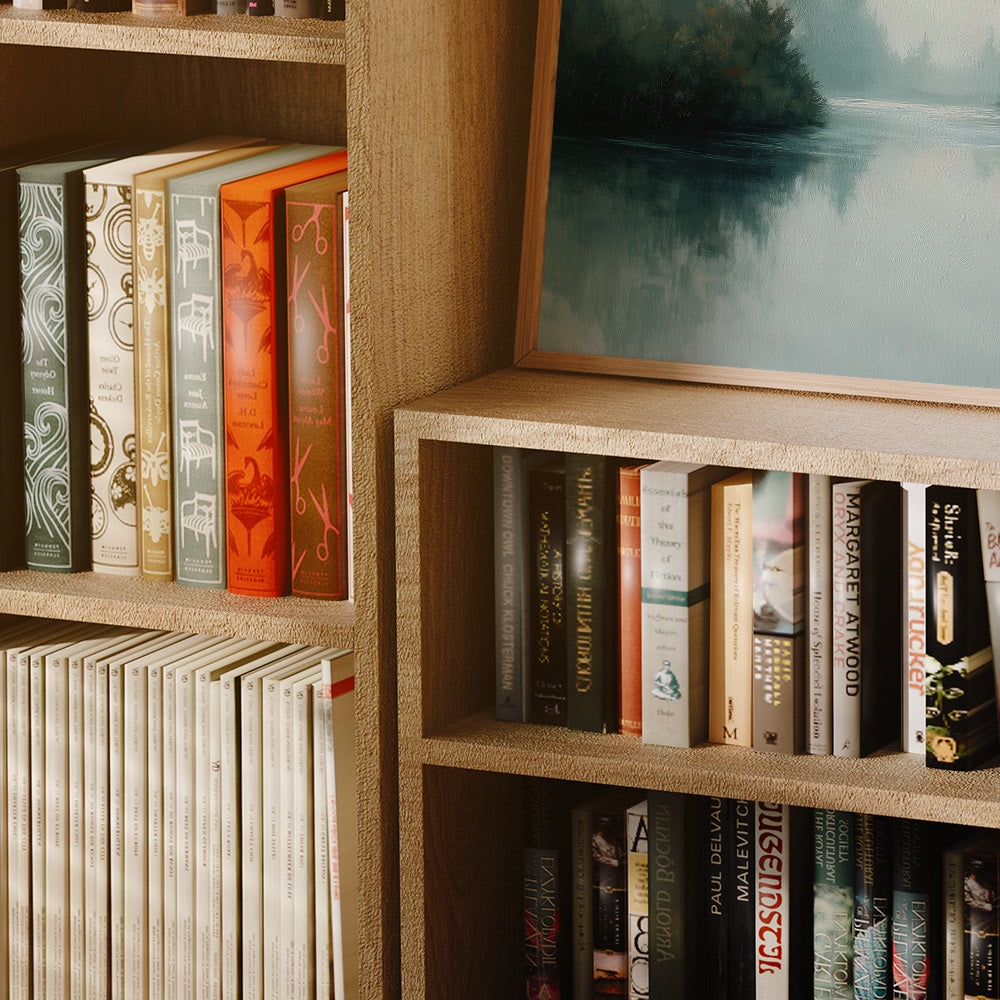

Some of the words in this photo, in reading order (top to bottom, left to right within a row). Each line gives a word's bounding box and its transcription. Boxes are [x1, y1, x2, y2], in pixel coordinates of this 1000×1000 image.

[834, 491, 846, 544] ORYX
[650, 536, 682, 550] Theory
[846, 492, 861, 606] MARGARET
[650, 570, 682, 582] Fiction
[834, 553, 846, 595] AND
[834, 600, 847, 670] CRAKE
[845, 611, 860, 697] ATWOOD
[709, 872, 723, 917] PAUL
